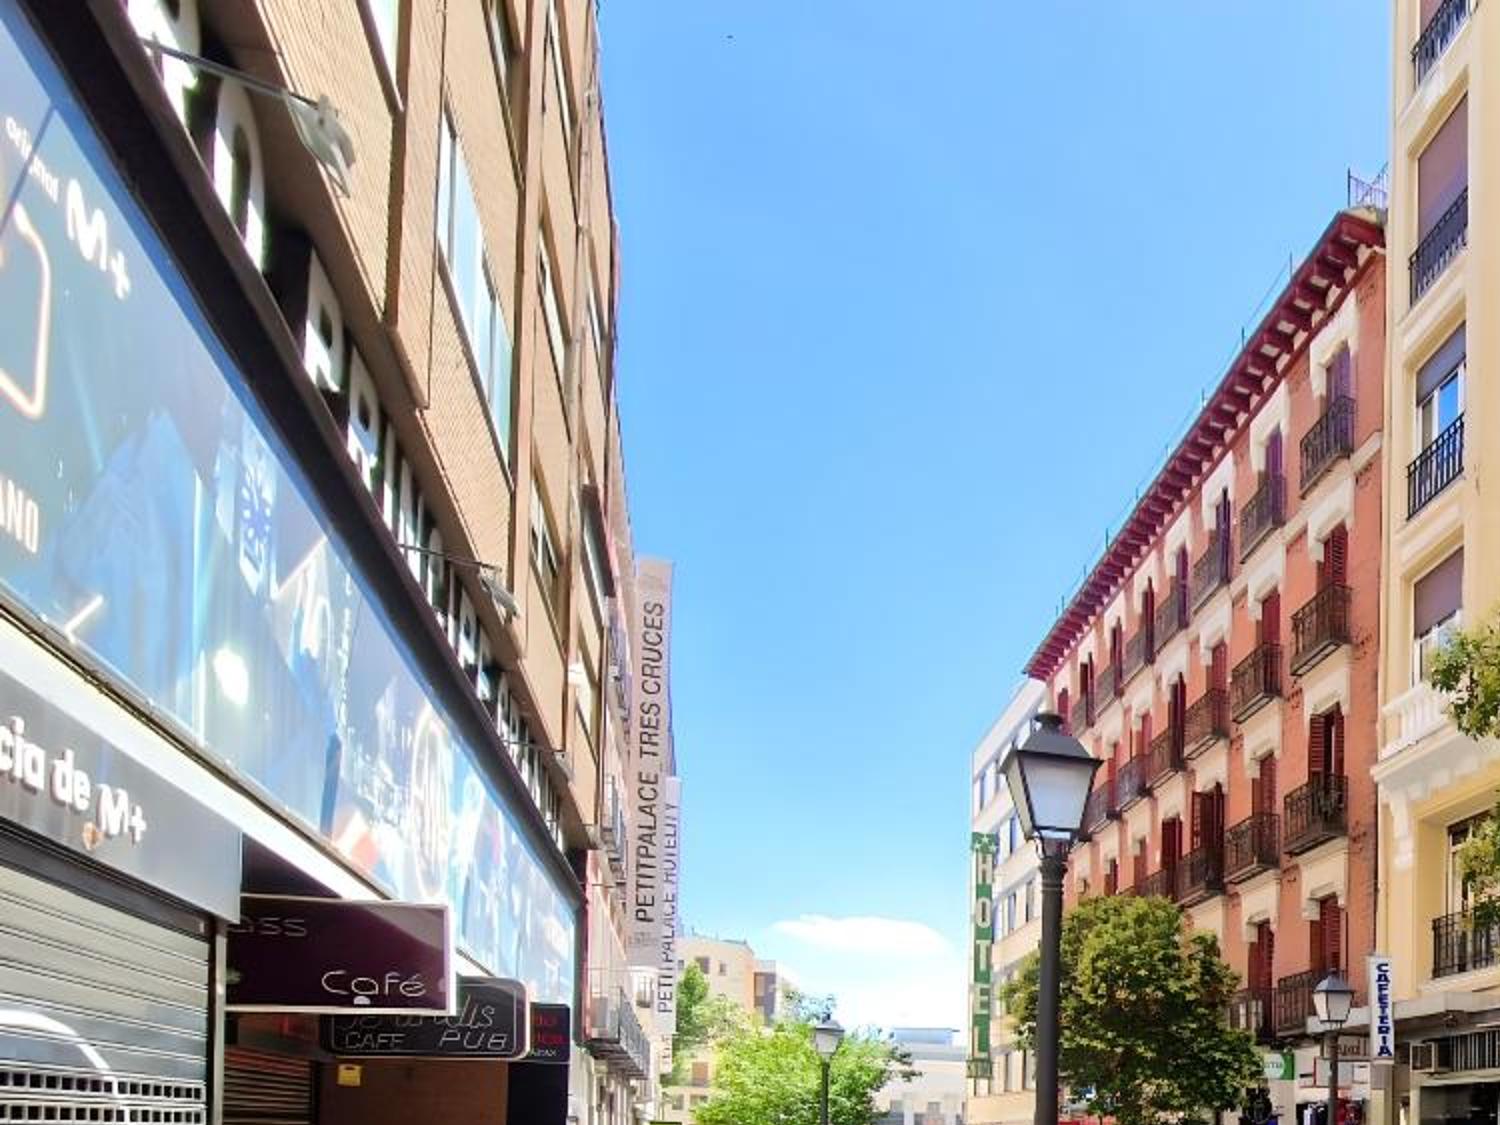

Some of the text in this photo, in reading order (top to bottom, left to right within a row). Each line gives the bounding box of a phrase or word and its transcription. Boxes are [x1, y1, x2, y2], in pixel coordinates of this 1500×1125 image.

[0, 475, 39, 554] NO
[52, 748, 91, 812] de
[98, 783, 147, 843] M+
[635, 601, 664, 923] PETITPALACE TRES CRUCES
[321, 970, 427, 997] Café
[974, 851, 994, 1059] HOTEL
[439, 1029, 508, 1050] PUB
[1376, 963, 1393, 1057] CAFETERIA
